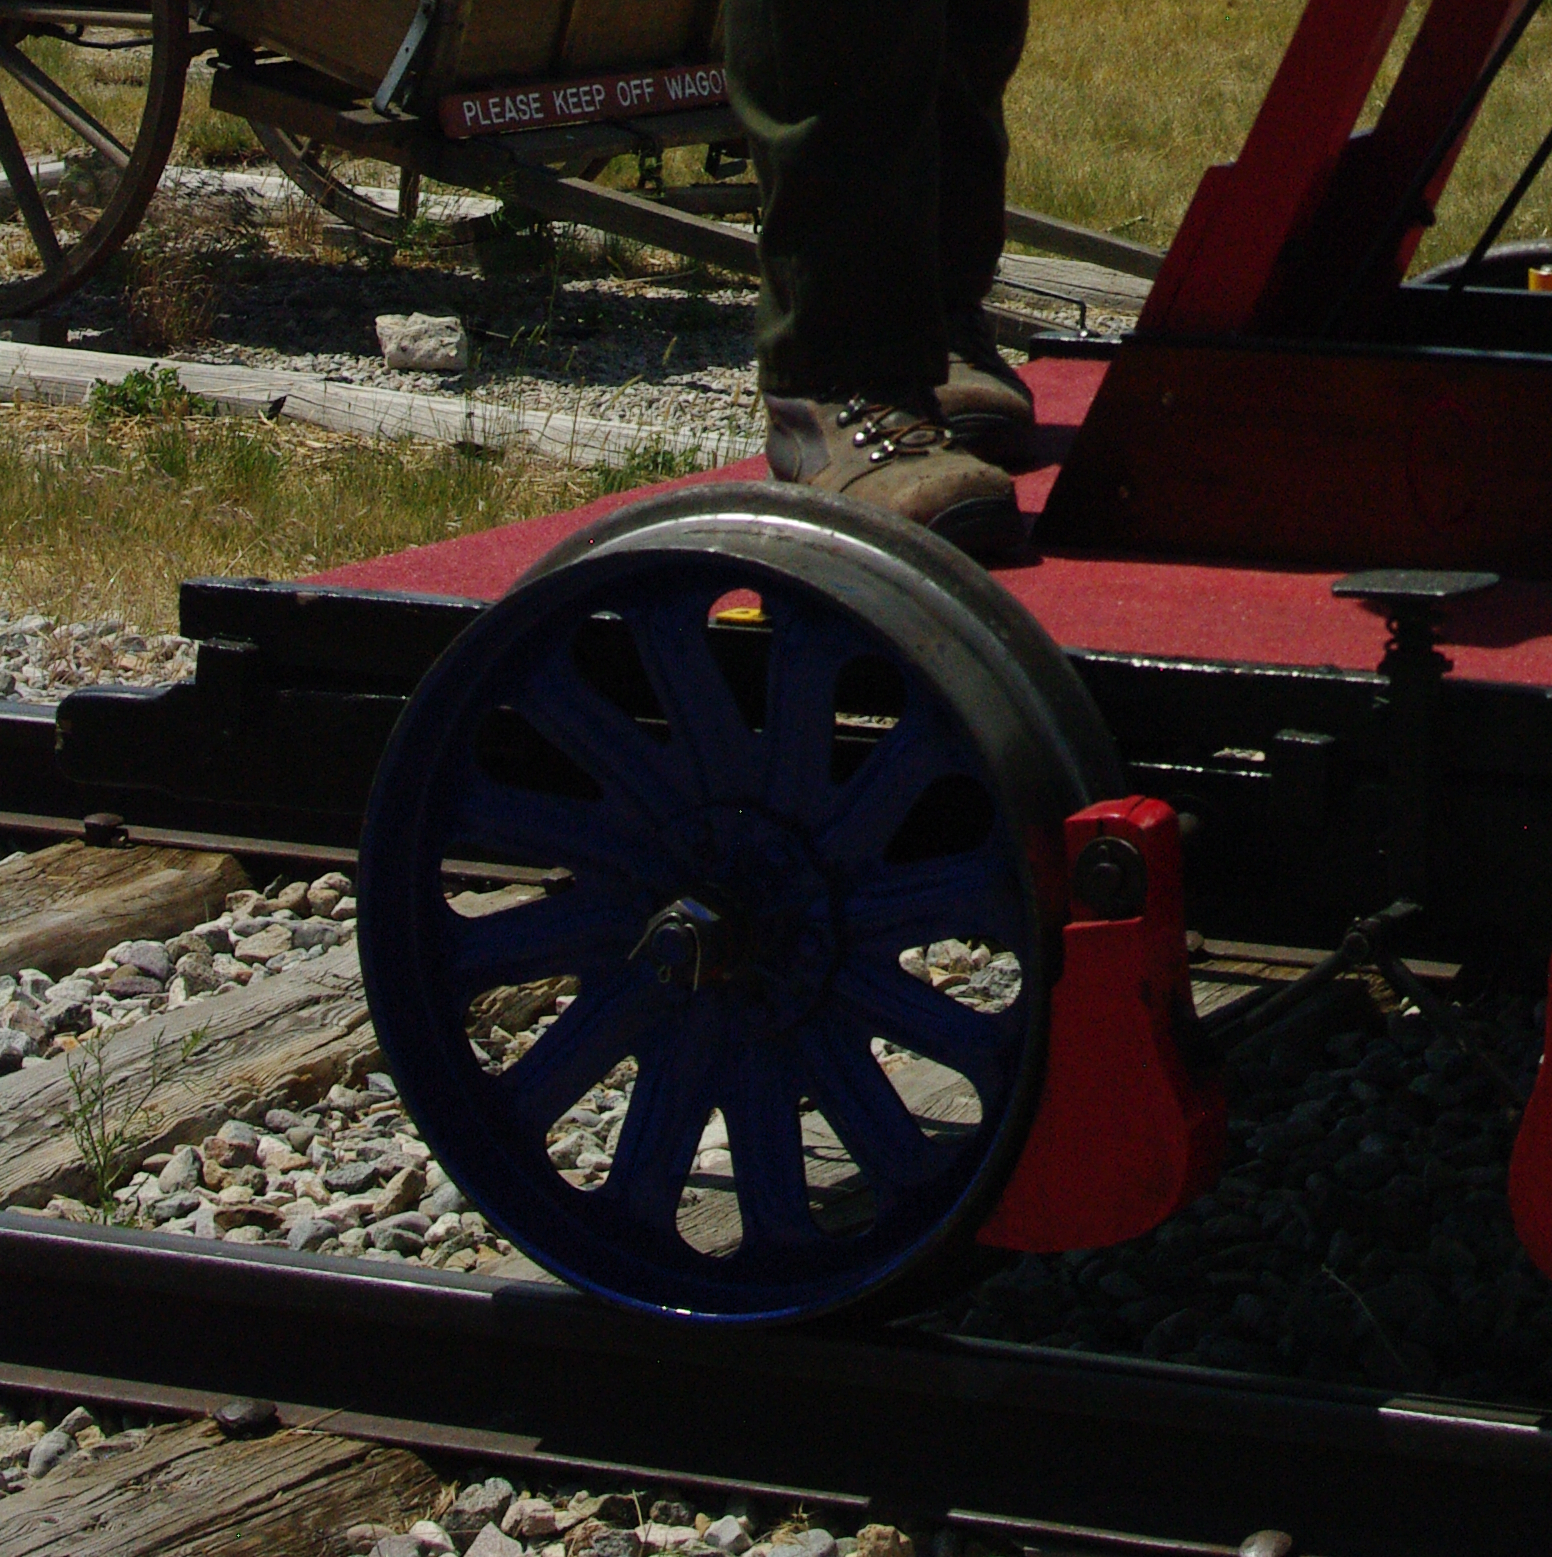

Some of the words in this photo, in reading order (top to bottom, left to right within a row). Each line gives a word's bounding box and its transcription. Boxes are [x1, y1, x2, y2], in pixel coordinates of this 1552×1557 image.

[463, 92, 544, 127] PLEASE
[552, 83, 606, 116] KEEP
[616, 77, 655, 107] OFF
